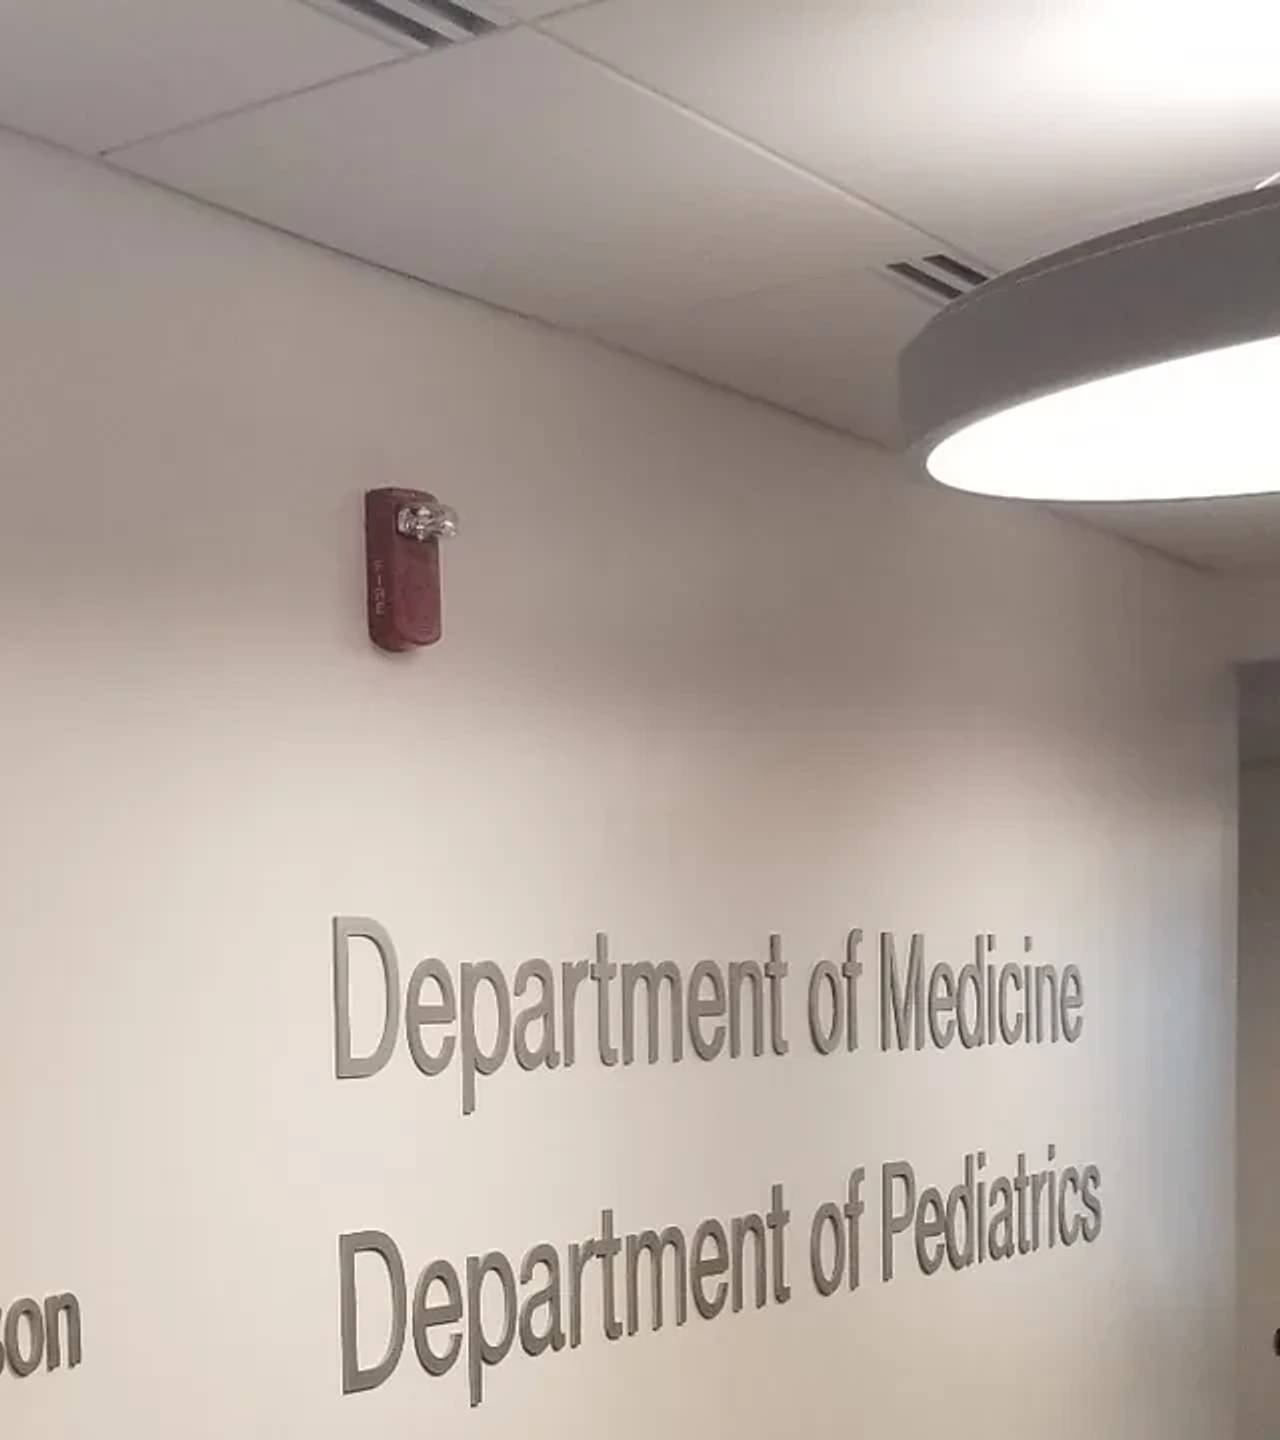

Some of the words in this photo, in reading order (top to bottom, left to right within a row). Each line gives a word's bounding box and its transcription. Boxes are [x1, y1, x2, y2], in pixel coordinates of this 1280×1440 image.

[332, 916, 789, 1115] Department
[808, 928, 863, 1056] of
[880, 931, 1084, 1052] Medicine
[339, 1184, 791, 1407] Department
[810, 1166, 865, 1297] of
[882, 1144, 1102, 1283] Pediatrics
